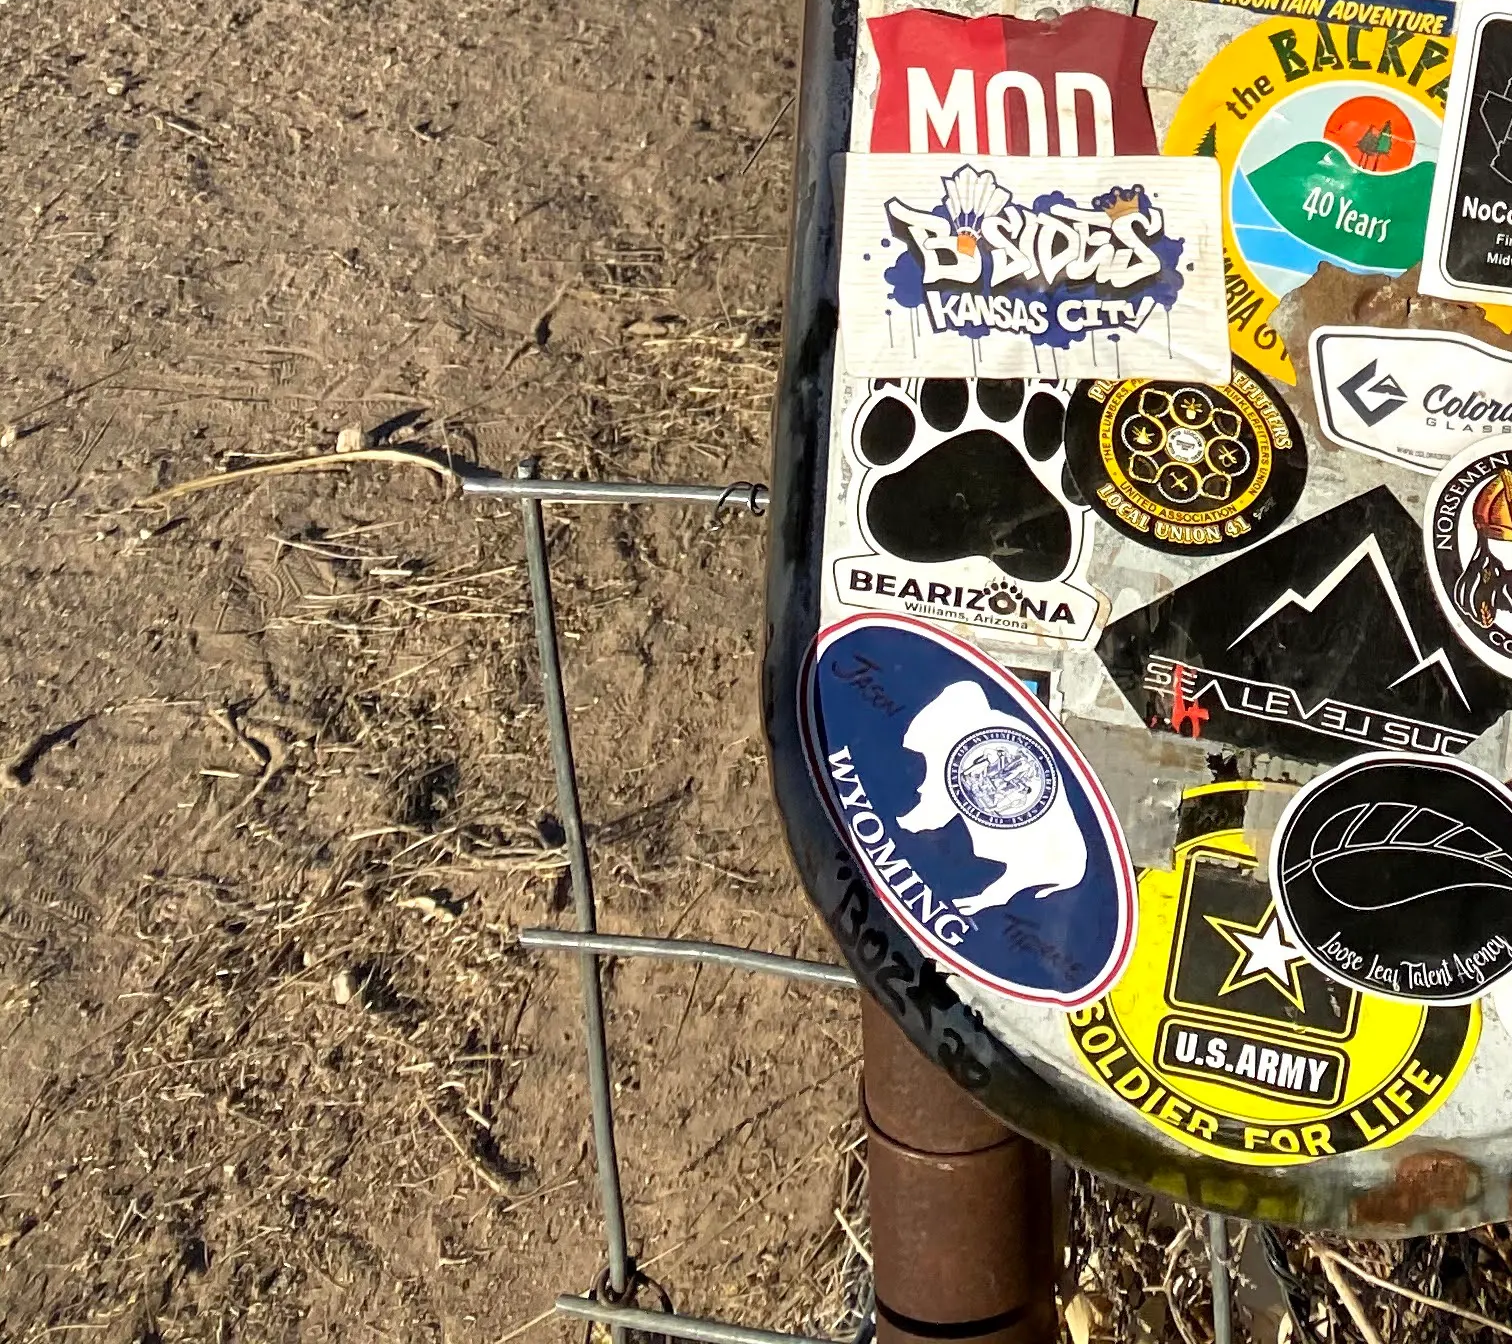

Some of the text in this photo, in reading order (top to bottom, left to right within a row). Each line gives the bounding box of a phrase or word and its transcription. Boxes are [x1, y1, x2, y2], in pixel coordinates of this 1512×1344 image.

[1327, 0, 1447, 36] ADVENTURE
[1225, 74, 1275, 120] the
[1302, 186, 1393, 244] 40 Years
[926, 289, 1160, 334] KANSAS CITY
[1232, 368, 1292, 450] EFITTERS
[1104, 441, 1115, 463] THE
[1119, 481, 1157, 513] UNITED
[1158, 505, 1237, 524] ASSOCIATION
[1249, 467, 1269, 496] UNION
[1436, 451, 1509, 551] NORSEMEN
[1097, 483, 1252, 544] LOCAL UNION 41
[848, 568, 1076, 625] BEARIZONA
[904, 601, 1029, 630] Williams, Arizona
[827, 744, 977, 948] WYOMING
[1317, 931, 1363, 971] Loose
[1364, 954, 1401, 992] Leaf
[1400, 960, 1453, 990] Talent
[1071, 1004, 1442, 1157] SOLDIER FOR LIFE
[1174, 1031, 1330, 1094] U.S.ARMY
